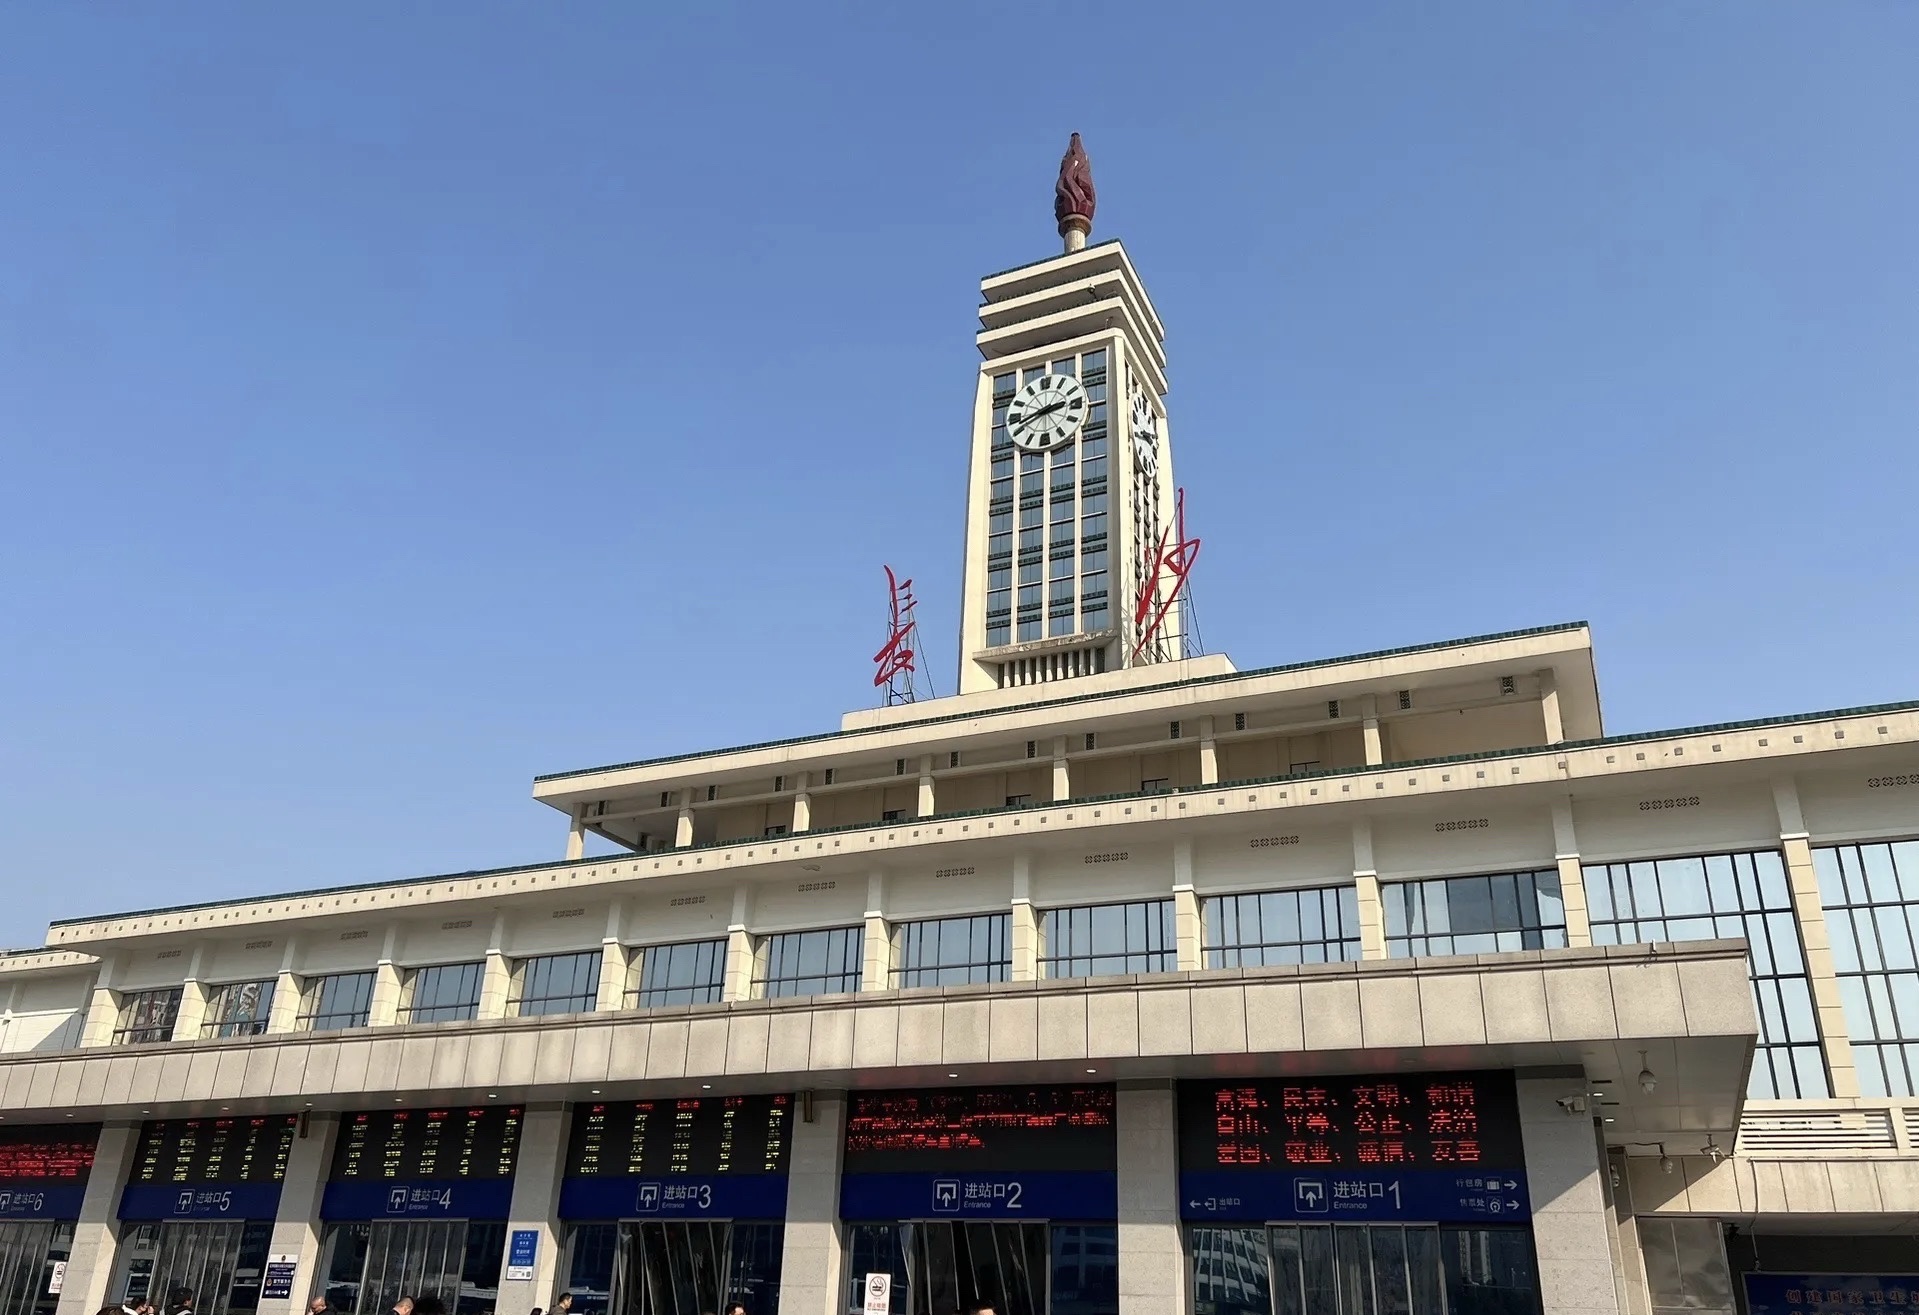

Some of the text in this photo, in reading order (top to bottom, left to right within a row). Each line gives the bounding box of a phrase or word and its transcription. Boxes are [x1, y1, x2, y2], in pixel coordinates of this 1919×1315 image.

[13, 1193, 44, 1211] 进站口 6
[196, 1191, 232, 1211] 进站口 5
[411, 1188, 451, 1209] 进站口 4
[664, 1184, 711, 1209] 进站口 3
[963, 1200, 992, 1209] Entrance
[965, 1182, 1022, 1208] 进站口 2
[1333, 1180, 1401, 1209] 进站口 1
[1333, 1201, 1368, 1210] Entrance
